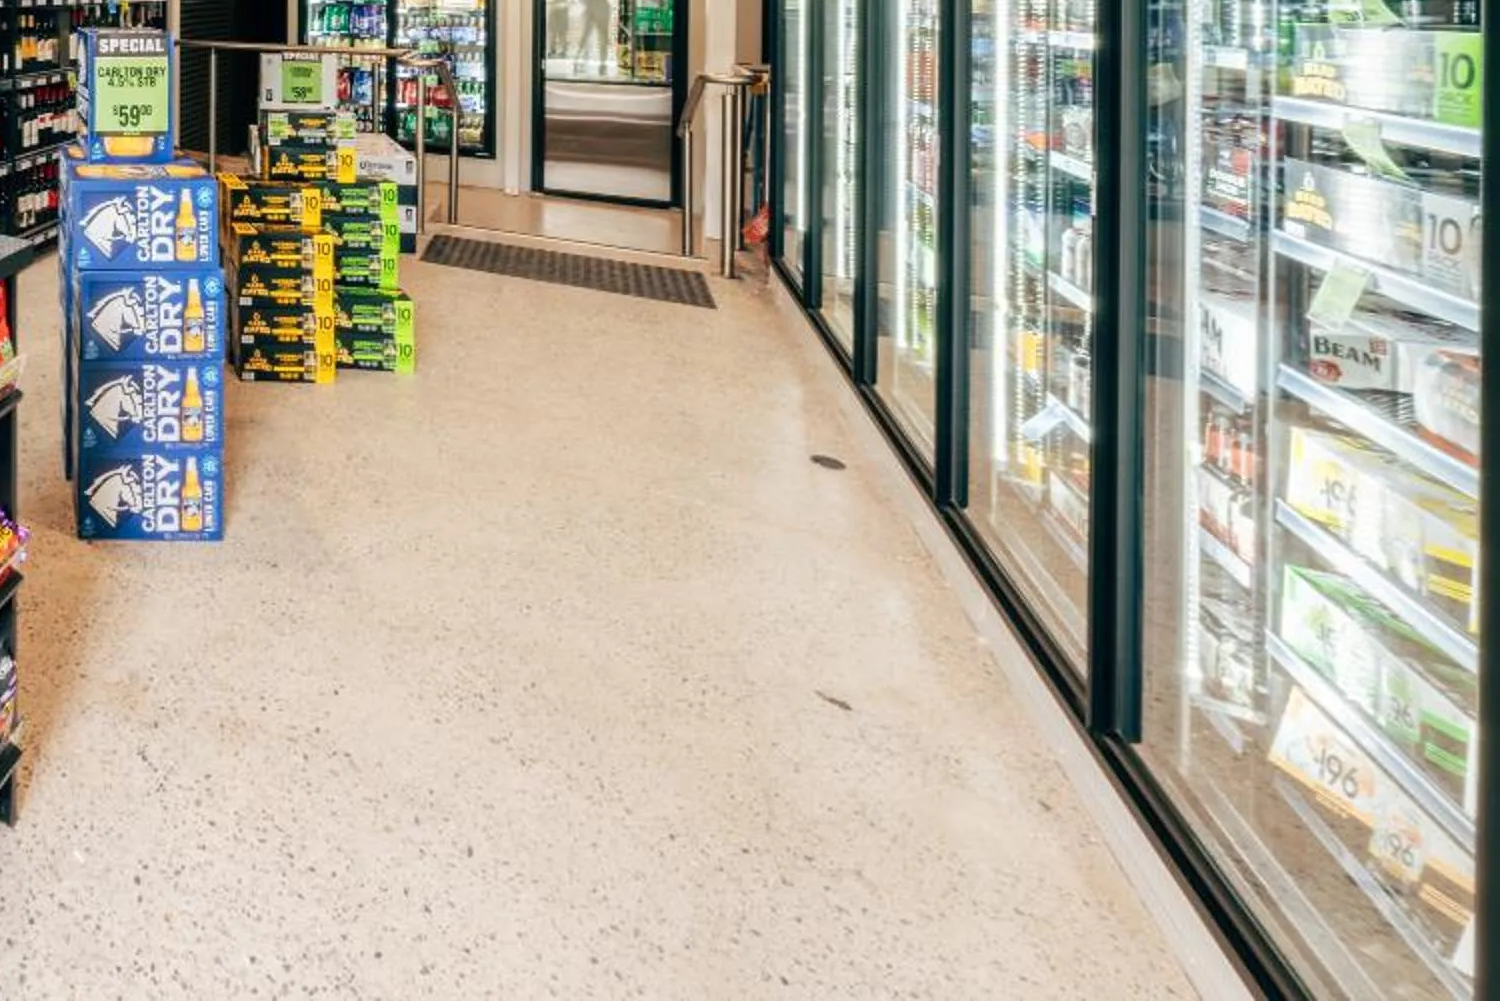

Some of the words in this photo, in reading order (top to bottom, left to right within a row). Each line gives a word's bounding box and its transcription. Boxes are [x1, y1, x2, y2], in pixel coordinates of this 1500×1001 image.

[99, 38, 165, 53] SPECIAL
[98, 66, 142, 78] CARLTON
[146, 66, 167, 77] DRY
[1439, 52, 1476, 91] 10
[340, 156, 353, 167] 10
[305, 196, 318, 209] 10
[382, 189, 395, 202] 10
[136, 186, 150, 261] CARLTON
[151, 186, 175, 261] DRY
[384, 224, 397, 237] 10
[1427, 212, 1464, 256] 10
[317, 242, 331, 256] 10
[383, 258, 396, 271] 10
[317, 278, 330, 292] 10
[143, 276, 158, 354] CARLTON
[159, 276, 182, 354] DRY
[397, 309, 411, 322] 10
[319, 316, 333, 330] 10
[399, 344, 412, 357] 10
[1313, 335, 1382, 373] BEAM
[321, 355, 333, 368] 10
[142, 364, 156, 442] CARLTON
[157, 364, 180, 442] DRY
[141, 454, 156, 532] CARLTON
[156, 454, 180, 532] DRY
